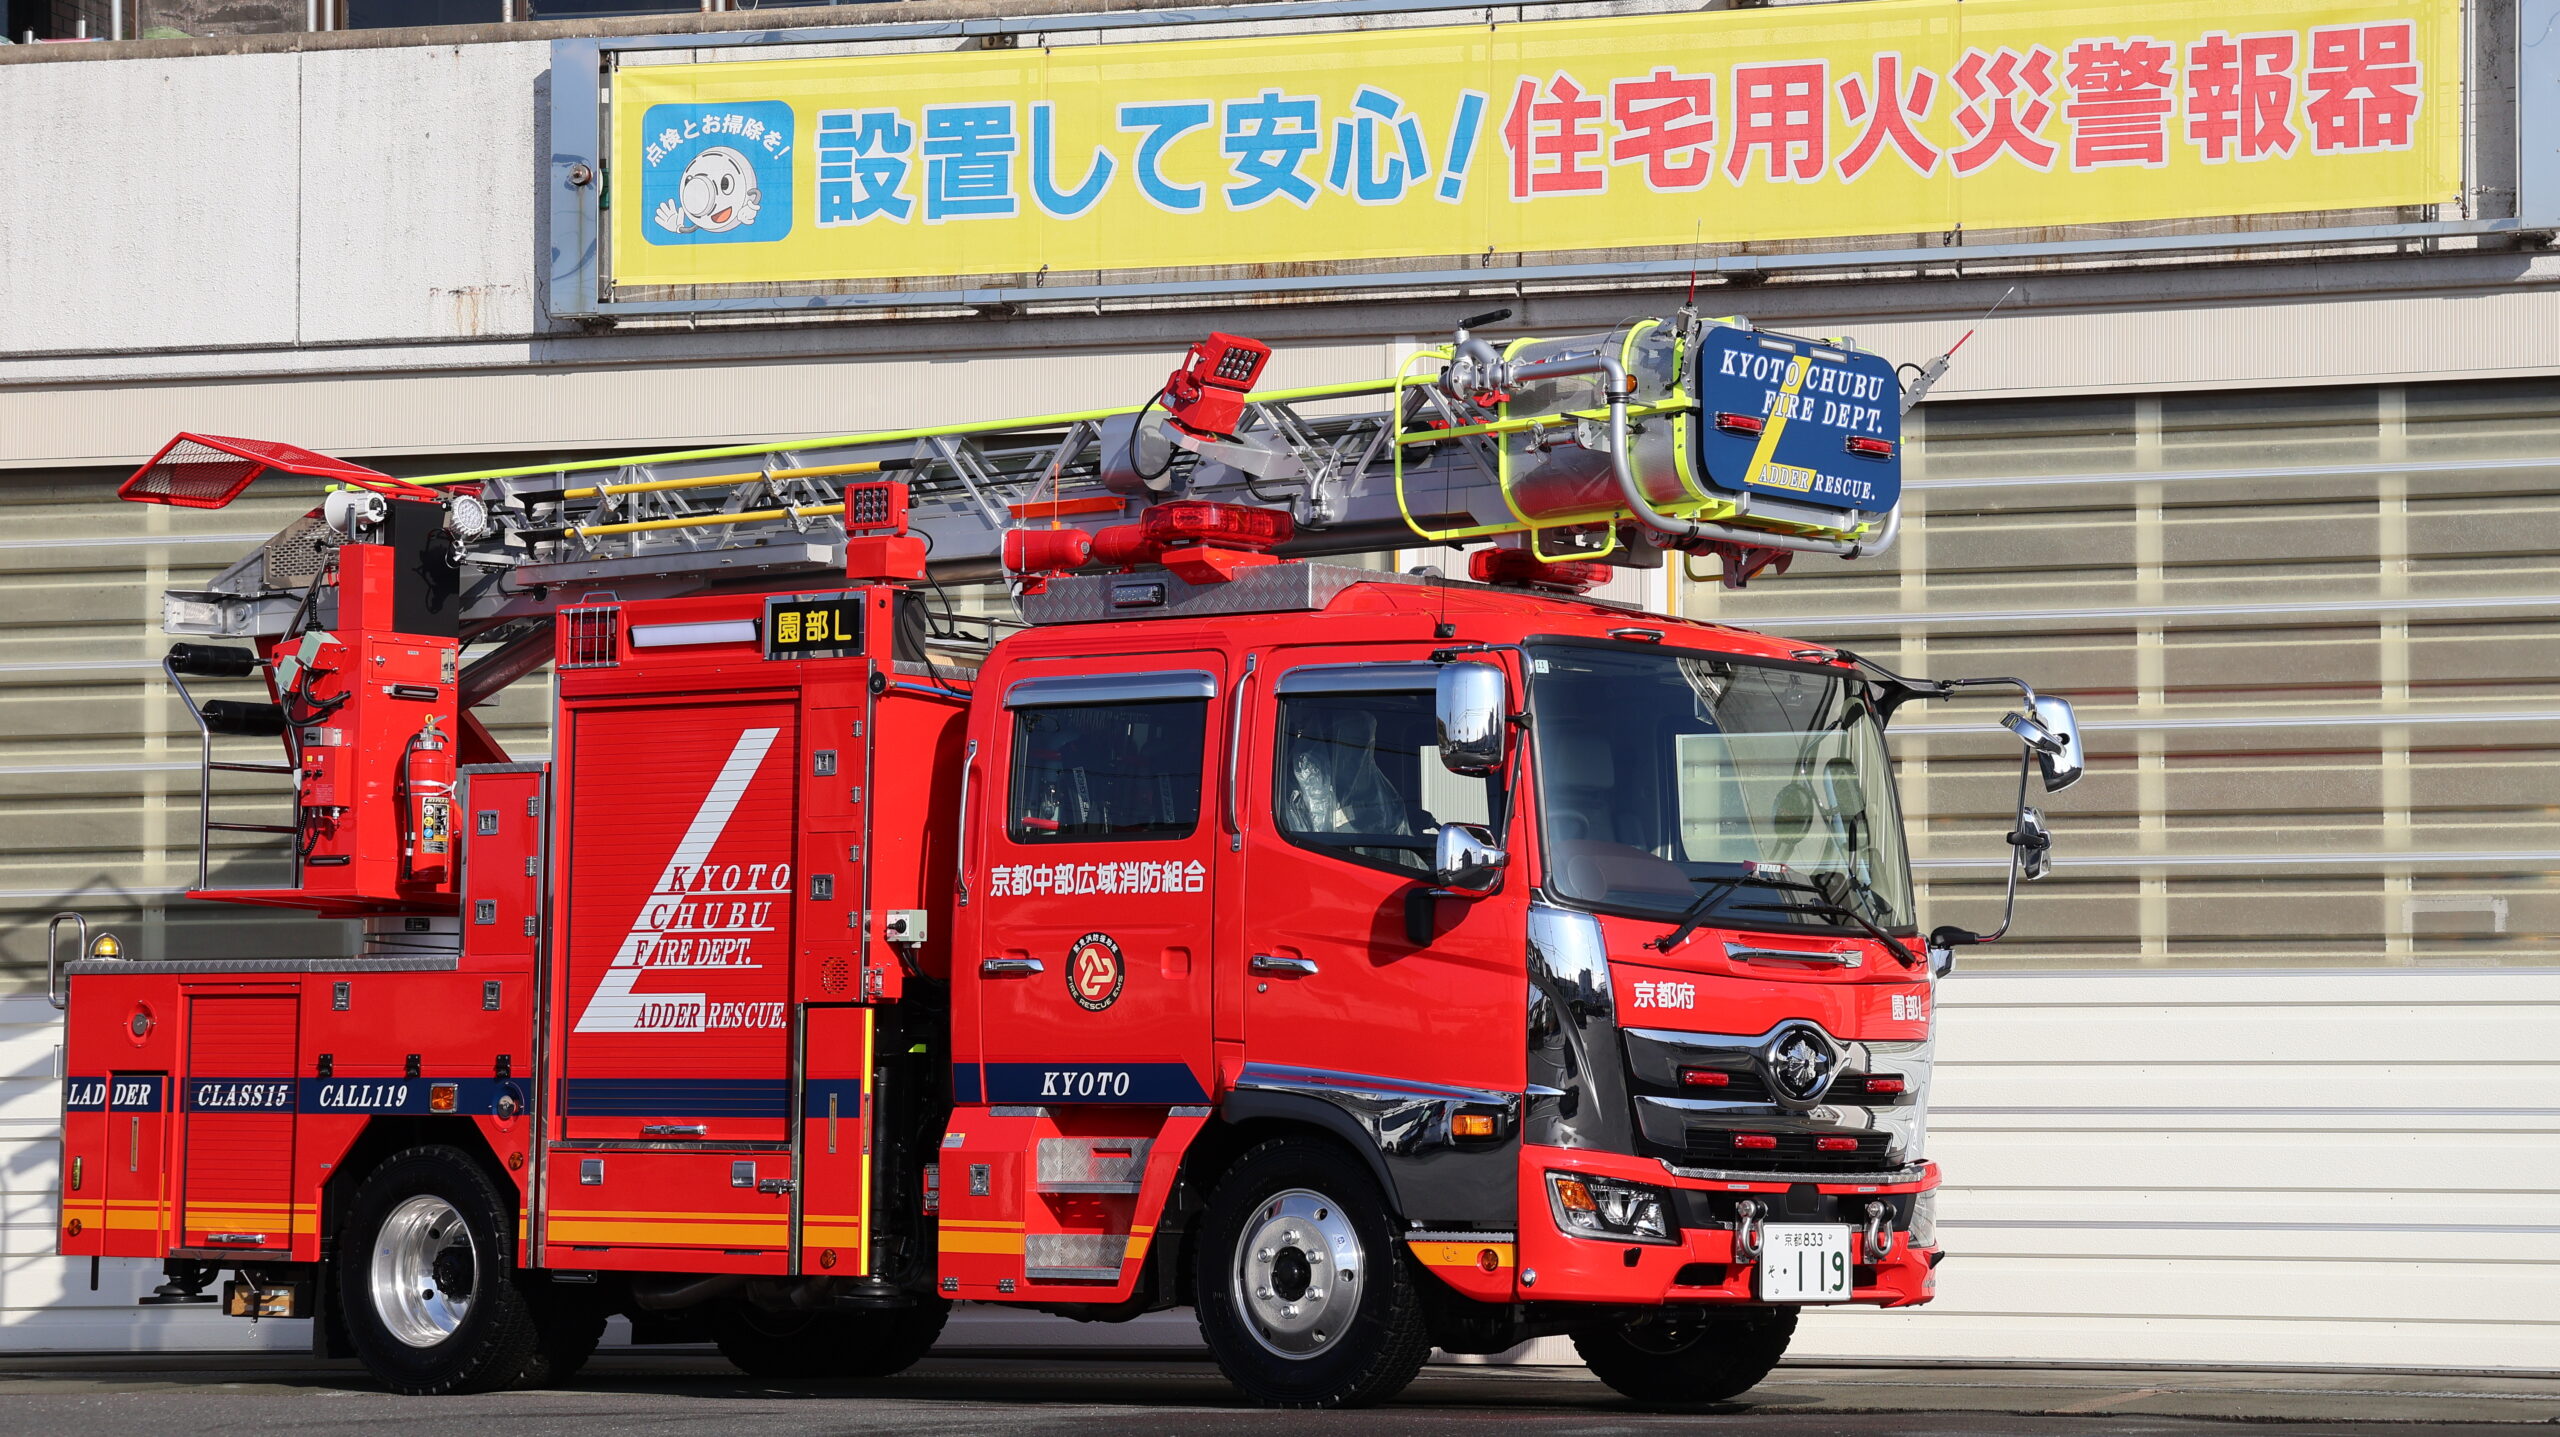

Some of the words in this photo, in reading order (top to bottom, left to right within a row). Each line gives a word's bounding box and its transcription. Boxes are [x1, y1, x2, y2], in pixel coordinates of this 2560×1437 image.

[646, 113, 791, 168] 点検とお掃除を!
[1720, 349, 1801, 387] KYOTO
[1805, 364, 1884, 401] CHUBU
[1761, 390, 1815, 424] FIRE
[1822, 401, 1883, 434] DEPT.
[1814, 473, 1876, 501] RESCUE.
[777, 609, 852, 643] 園部L
[668, 863, 791, 893] KYOTO
[990, 860, 1206, 897] 京都中部広域消防組合
[649, 901, 773, 929] CHUBU
[632, 938, 692, 967] FIRE
[693, 937, 751, 966] DEPT.
[1067, 975, 1079, 999] FIRE
[1078, 998, 1113, 1010] RESCUE
[1112, 975, 1124, 998] EMS
[1632, 980, 1696, 1010] 京都府
[705, 1001, 787, 1029] RESCUE.
[1041, 1071, 1130, 1096] KYOTO
